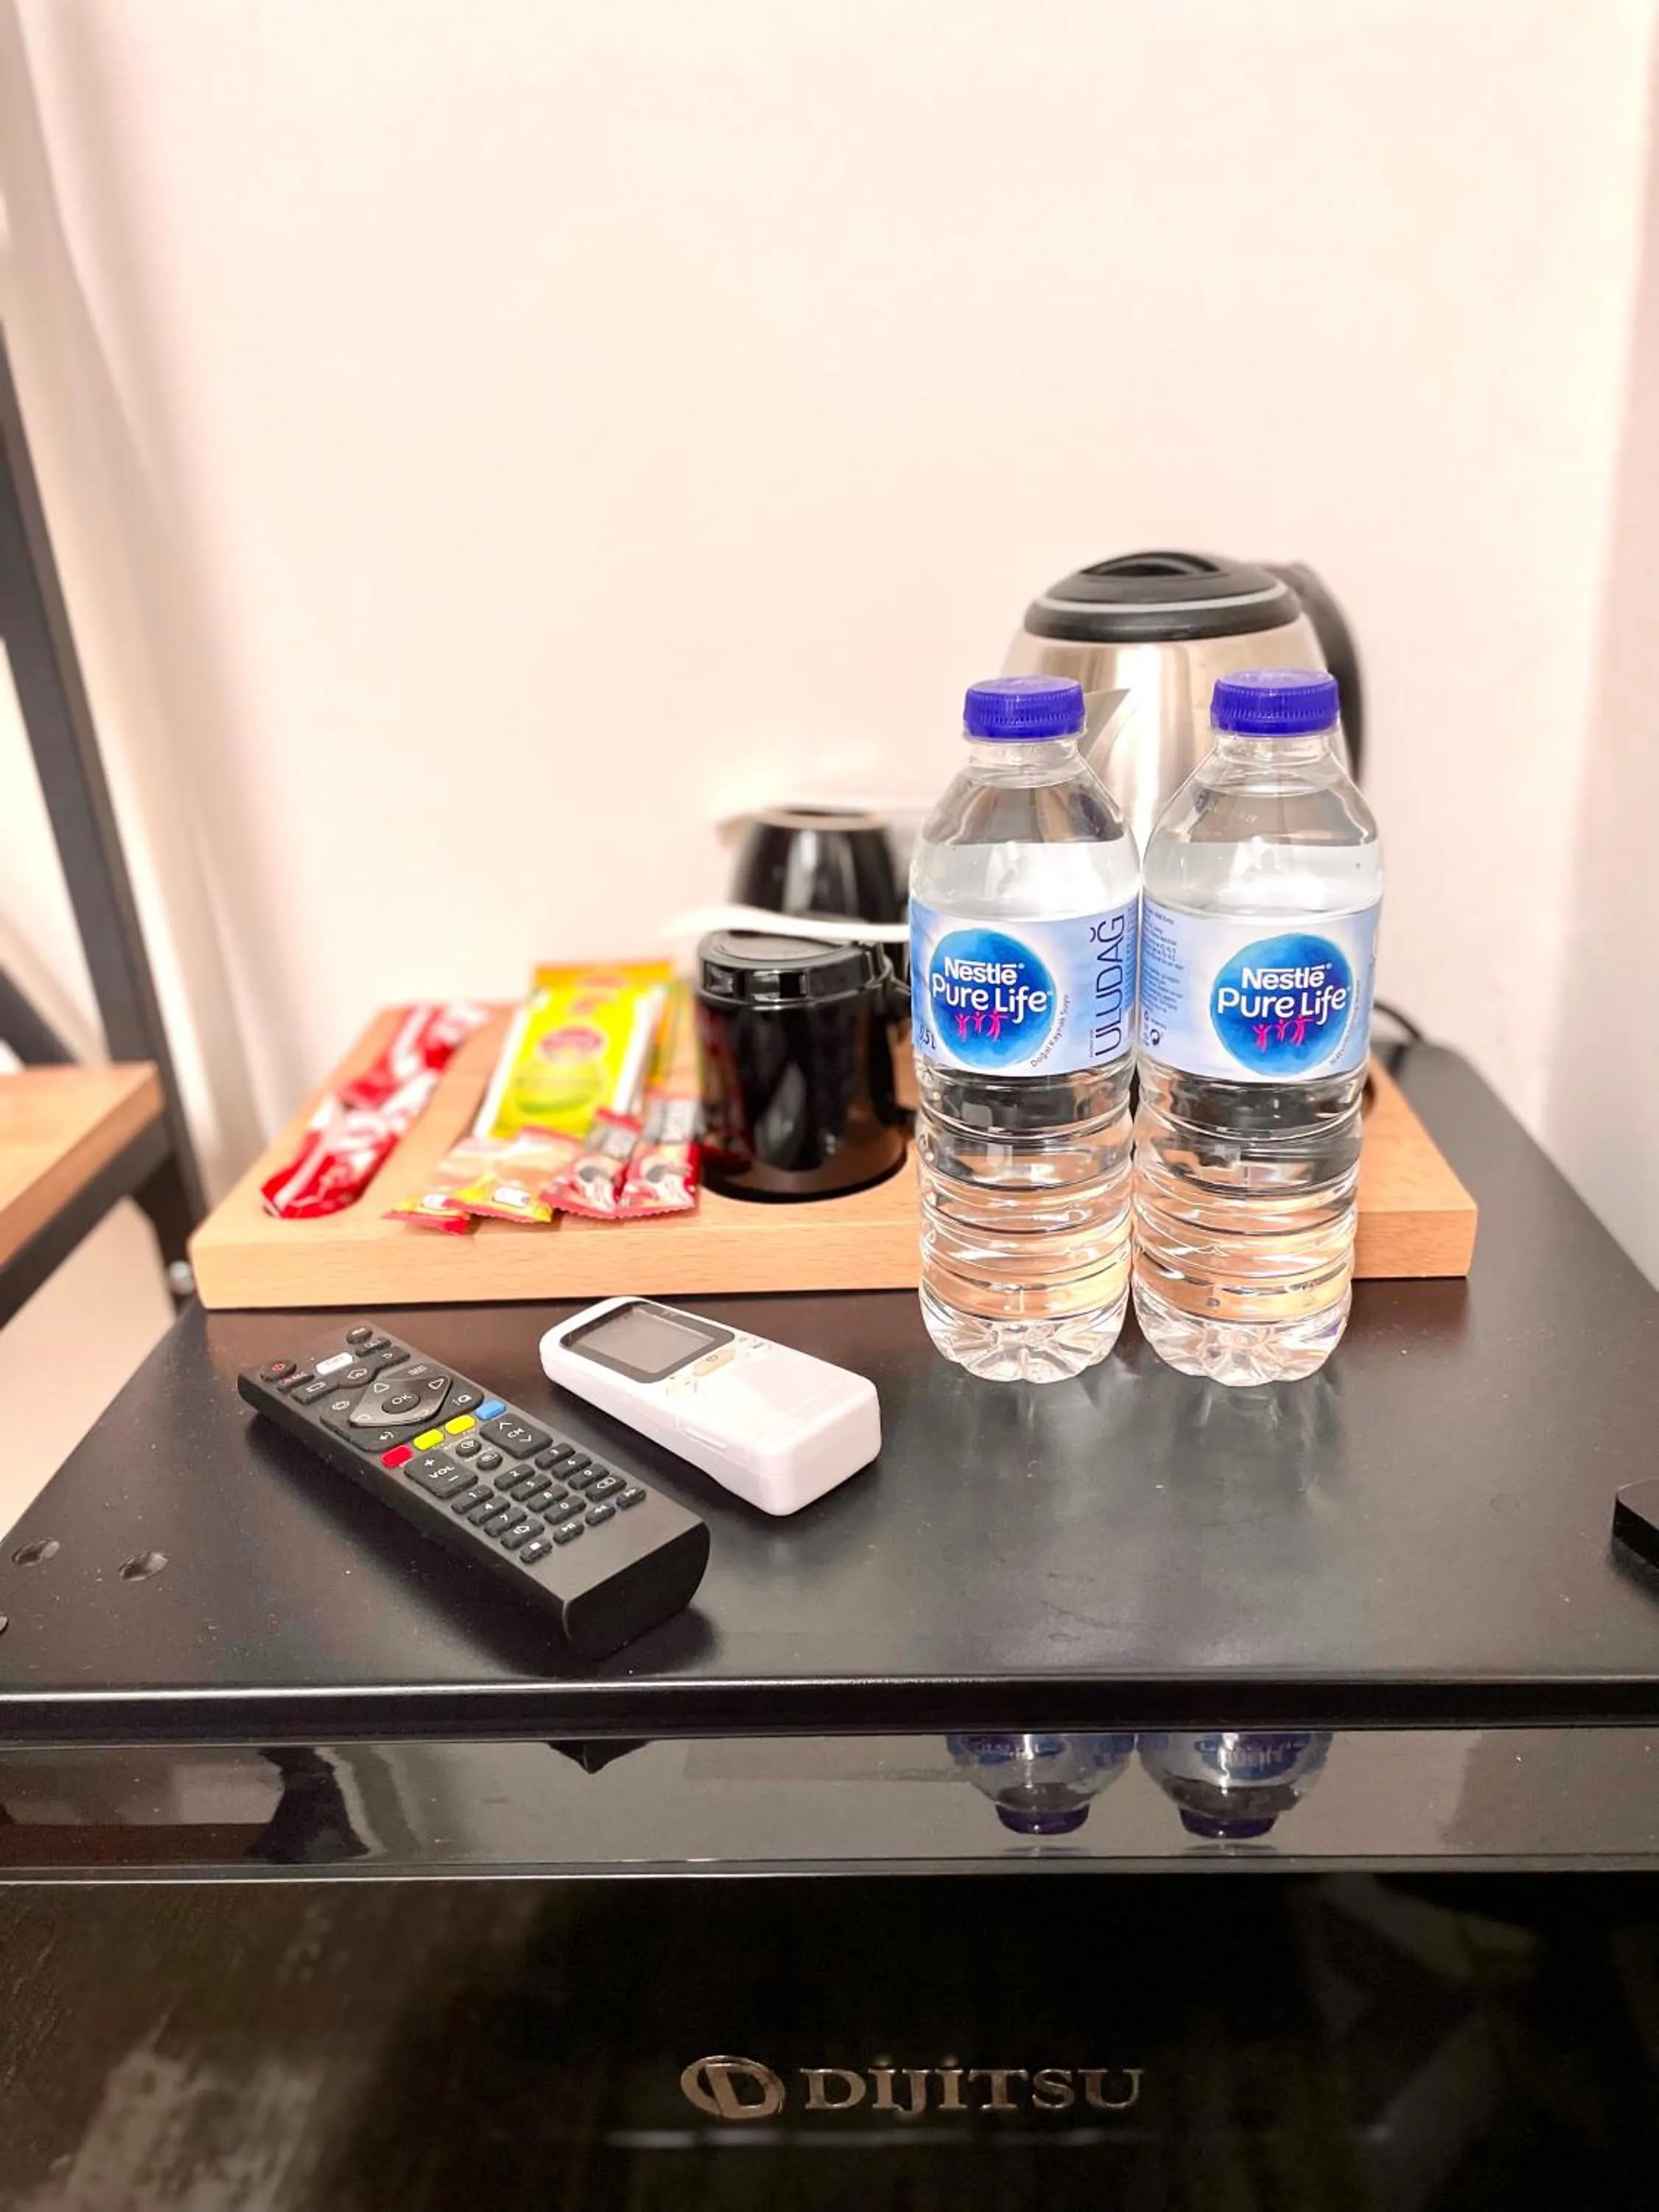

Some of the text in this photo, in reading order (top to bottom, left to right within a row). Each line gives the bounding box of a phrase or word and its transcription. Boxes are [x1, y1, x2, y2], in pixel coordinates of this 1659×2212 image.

[932, 973, 1047, 1024] Pure Life
[1090, 914, 1124, 1057] ULUDAĞ
[1217, 987, 1294, 1018] Pure
[1301, 985, 1346, 1026] Life
[392, 1394, 412, 1405] OK
[507, 1427, 525, 1439] CH
[429, 1466, 455, 1479] VOL
